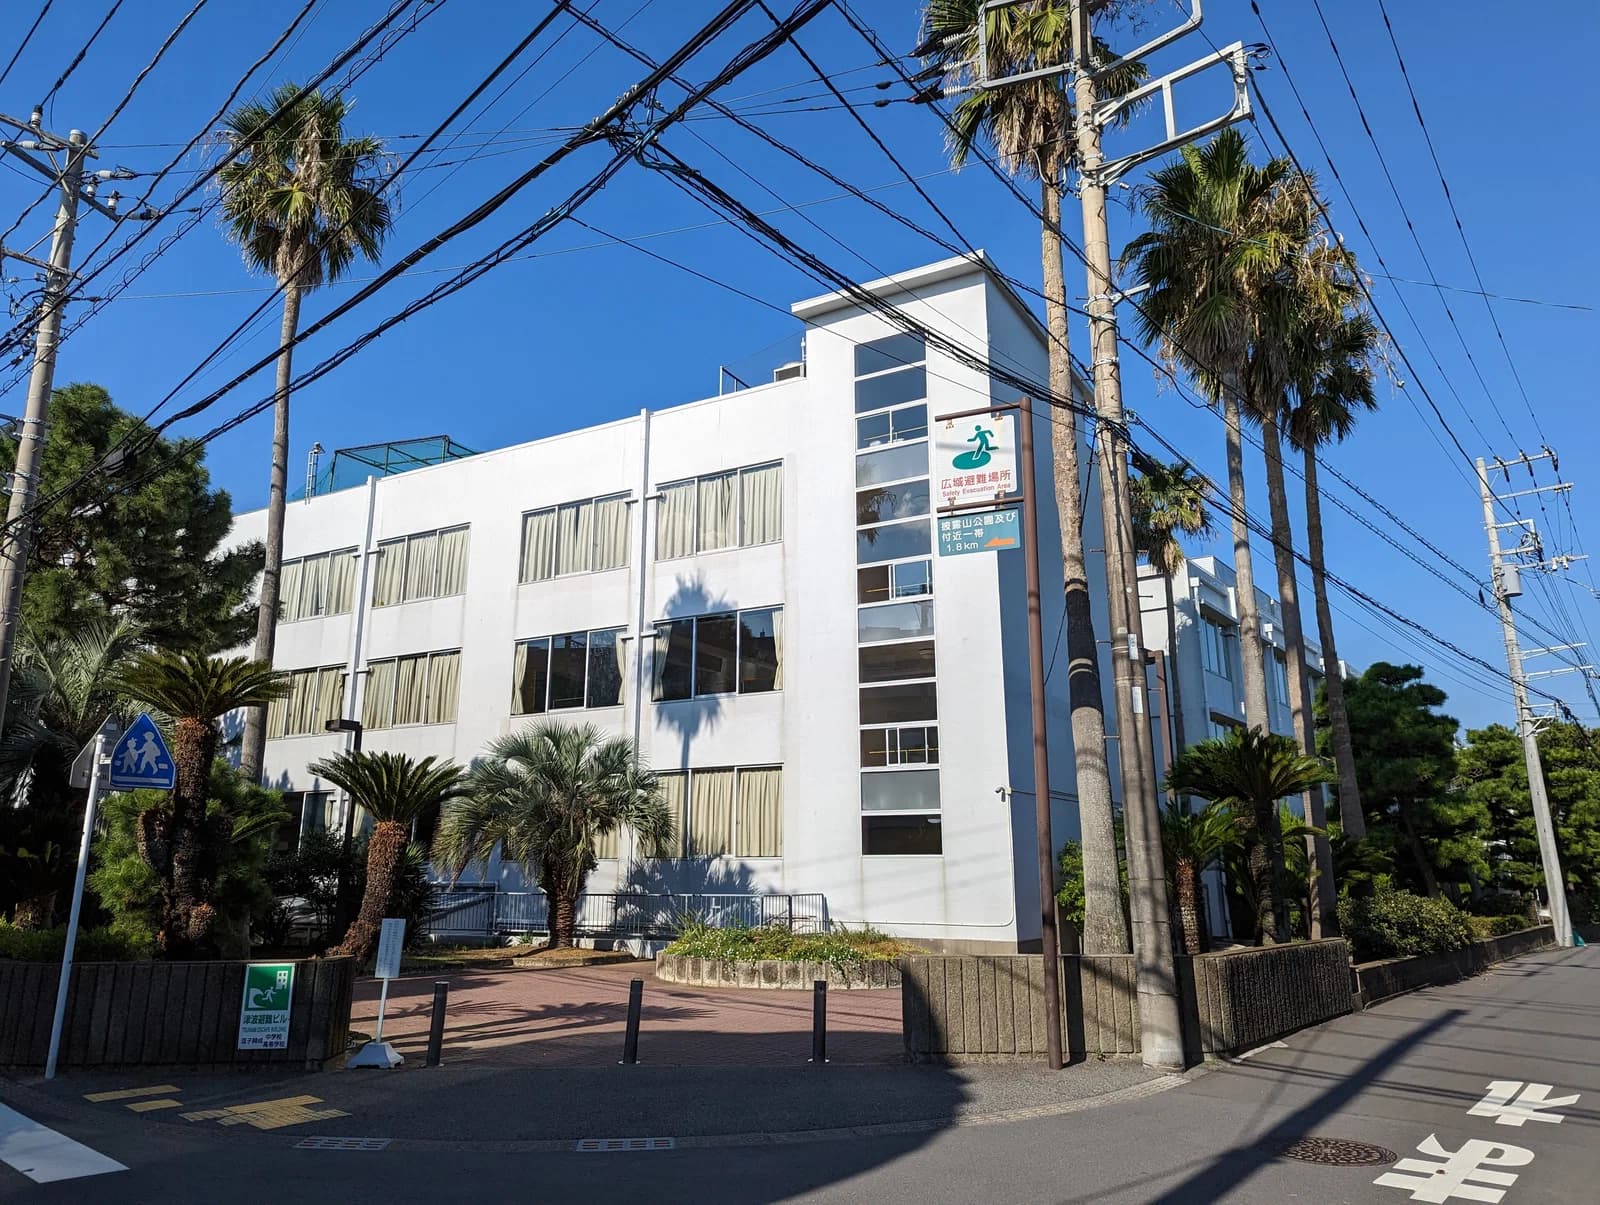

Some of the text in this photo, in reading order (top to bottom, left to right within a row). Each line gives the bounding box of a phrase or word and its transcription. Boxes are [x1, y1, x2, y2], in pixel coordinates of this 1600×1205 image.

[941, 469, 1011, 489] 広域避難場所
[962, 484, 994, 495] Evacuation
[942, 528, 984, 542] 付近一帯
